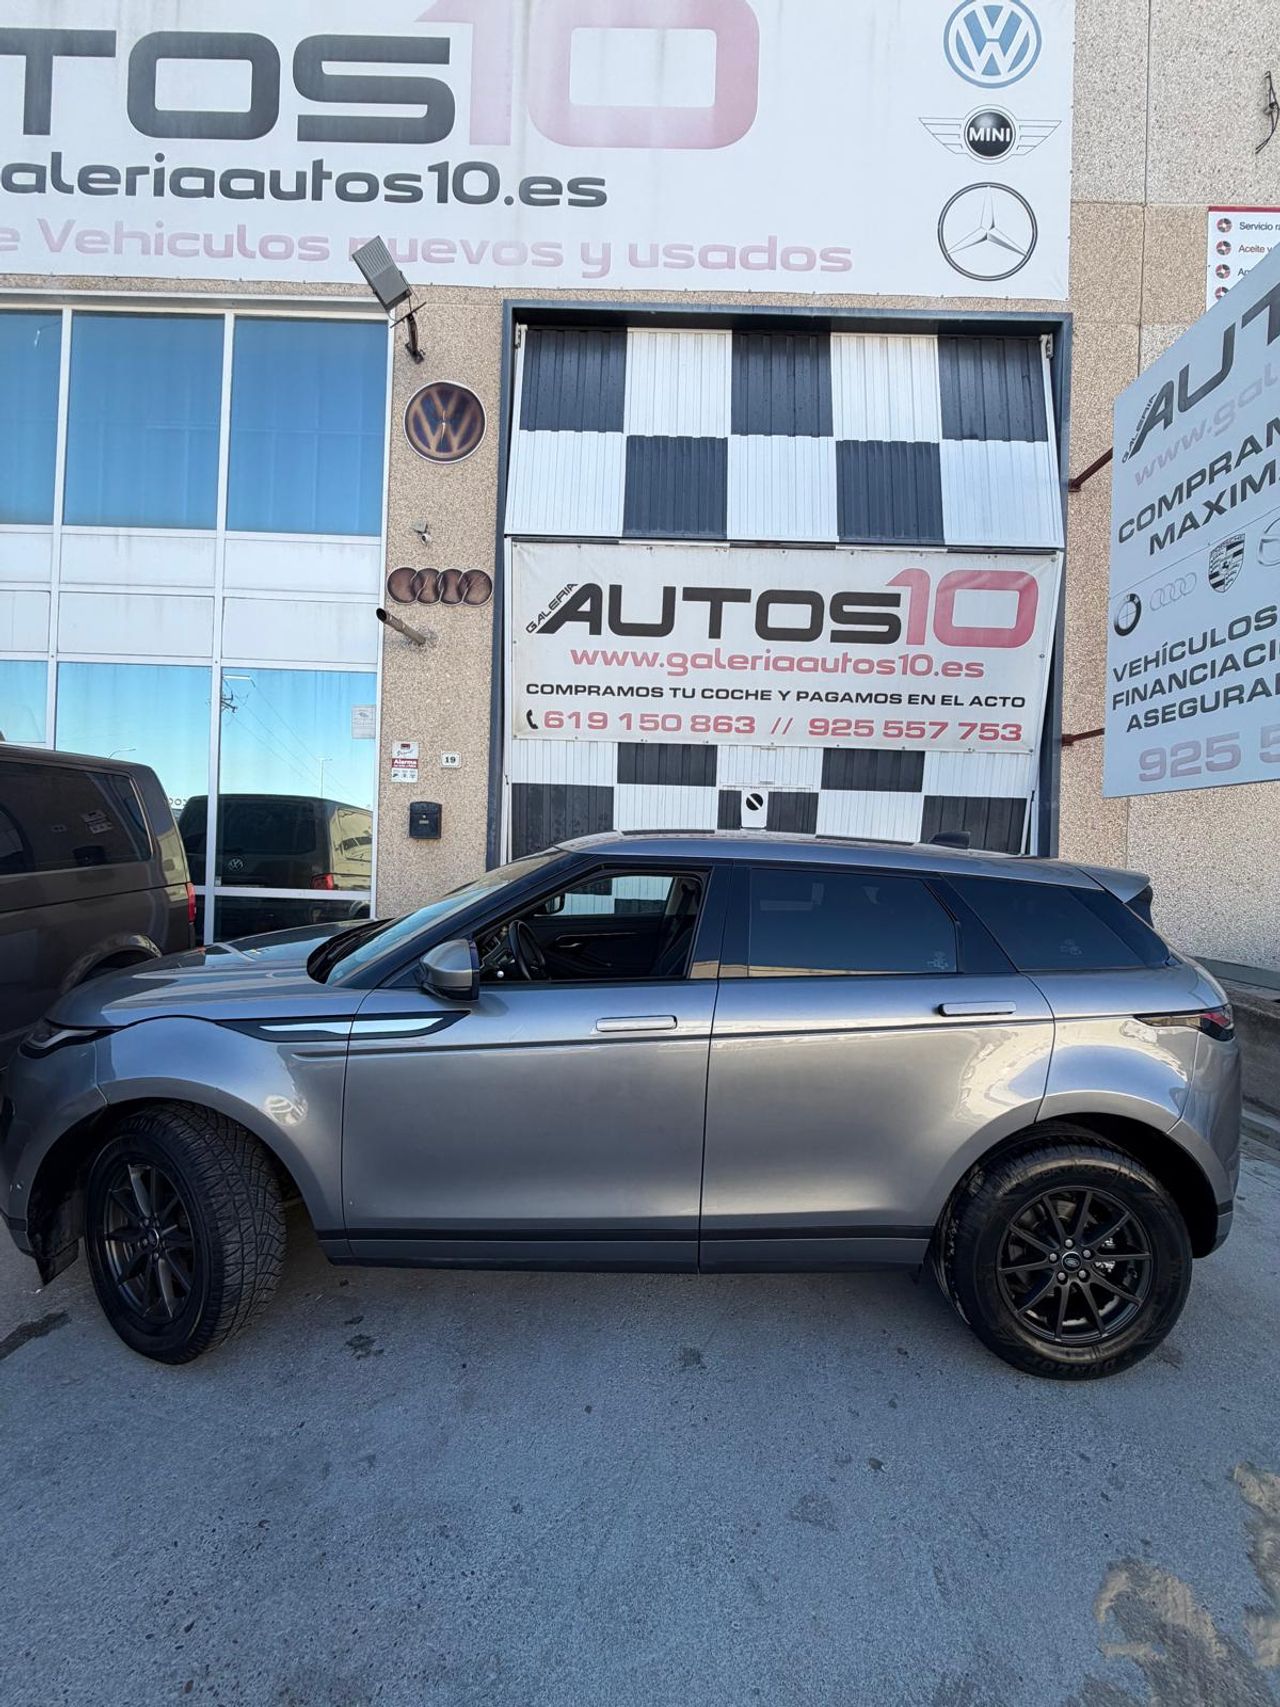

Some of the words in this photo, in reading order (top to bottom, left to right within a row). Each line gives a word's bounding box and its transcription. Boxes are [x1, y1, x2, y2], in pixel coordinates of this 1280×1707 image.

[969, 127, 1010, 142] MINI
[1238, 244, 1265, 253] Aceite
[1239, 221, 1273, 231] Servicio
[580, 243, 611, 279] y
[628, 235, 853, 272] usados
[1149, 458, 1280, 556] MAXIM
[525, 583, 579, 634] GALERIA
[535, 567, 1039, 649] AUTOS10
[569, 648, 985, 679] www.galeriaautos10.es
[1112, 604, 1278, 683] VEHÍCULOS
[526, 683, 664, 698] COMPRAMOS
[669, 688, 696, 699] TU
[700, 688, 772, 701] COCHE
[778, 690, 791, 701] Y
[796, 690, 903, 704] PAGAMOS
[907, 694, 936, 706] EN
[941, 696, 964, 706] EL
[968, 696, 1026, 708] ACTO
[1112, 639, 1280, 711] FINANCIACI
[543, 710, 608, 730] 619
[618, 713, 682, 732] 150
[690, 715, 756, 734] 863
[808, 717, 875, 737] 925
[882, 720, 949, 740] 557
[957, 722, 1023, 742] 753
[1126, 672, 1280, 734] ASEGURA
[1138, 731, 1242, 783] 925
